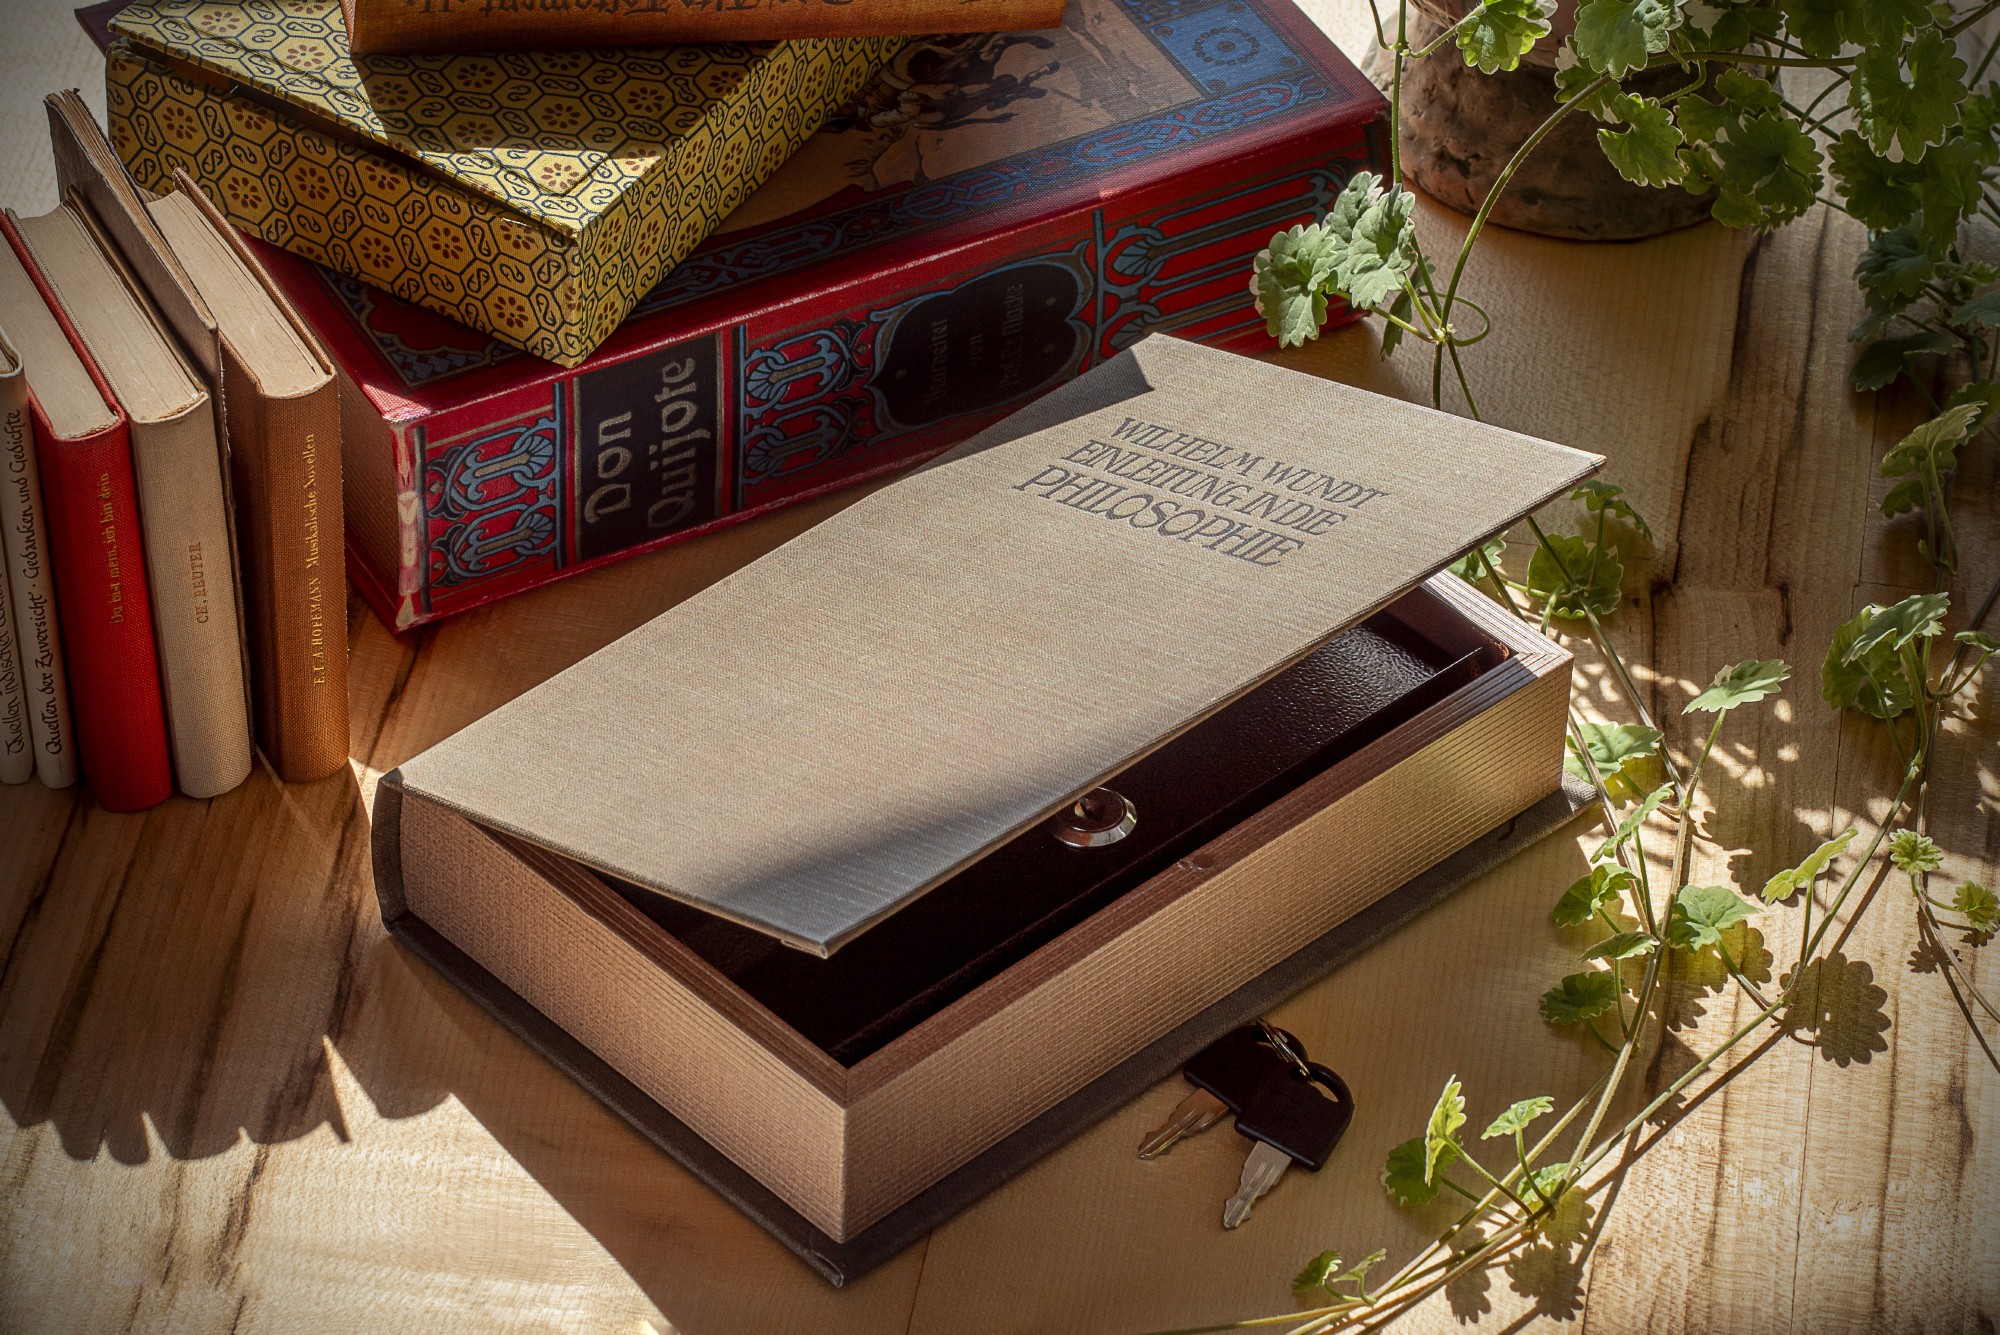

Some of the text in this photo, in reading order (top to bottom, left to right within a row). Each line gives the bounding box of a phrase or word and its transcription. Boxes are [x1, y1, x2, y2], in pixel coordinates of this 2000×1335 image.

[98, 473, 112, 498] dein
[584, 411, 632, 524] Don
[648, 358, 711, 528] Quijote
[1060, 439, 1348, 536] EINLEITUNG IN DIE
[1109, 417, 1391, 509] WILHELM WUNDT
[100, 503, 113, 524] bin
[1013, 464, 1305, 567] PHILOSOPHIE
[4, 409, 62, 755] Quellen der Zuversicht Gedanken und Gedichte
[2, 695, 25, 755] Quellen
